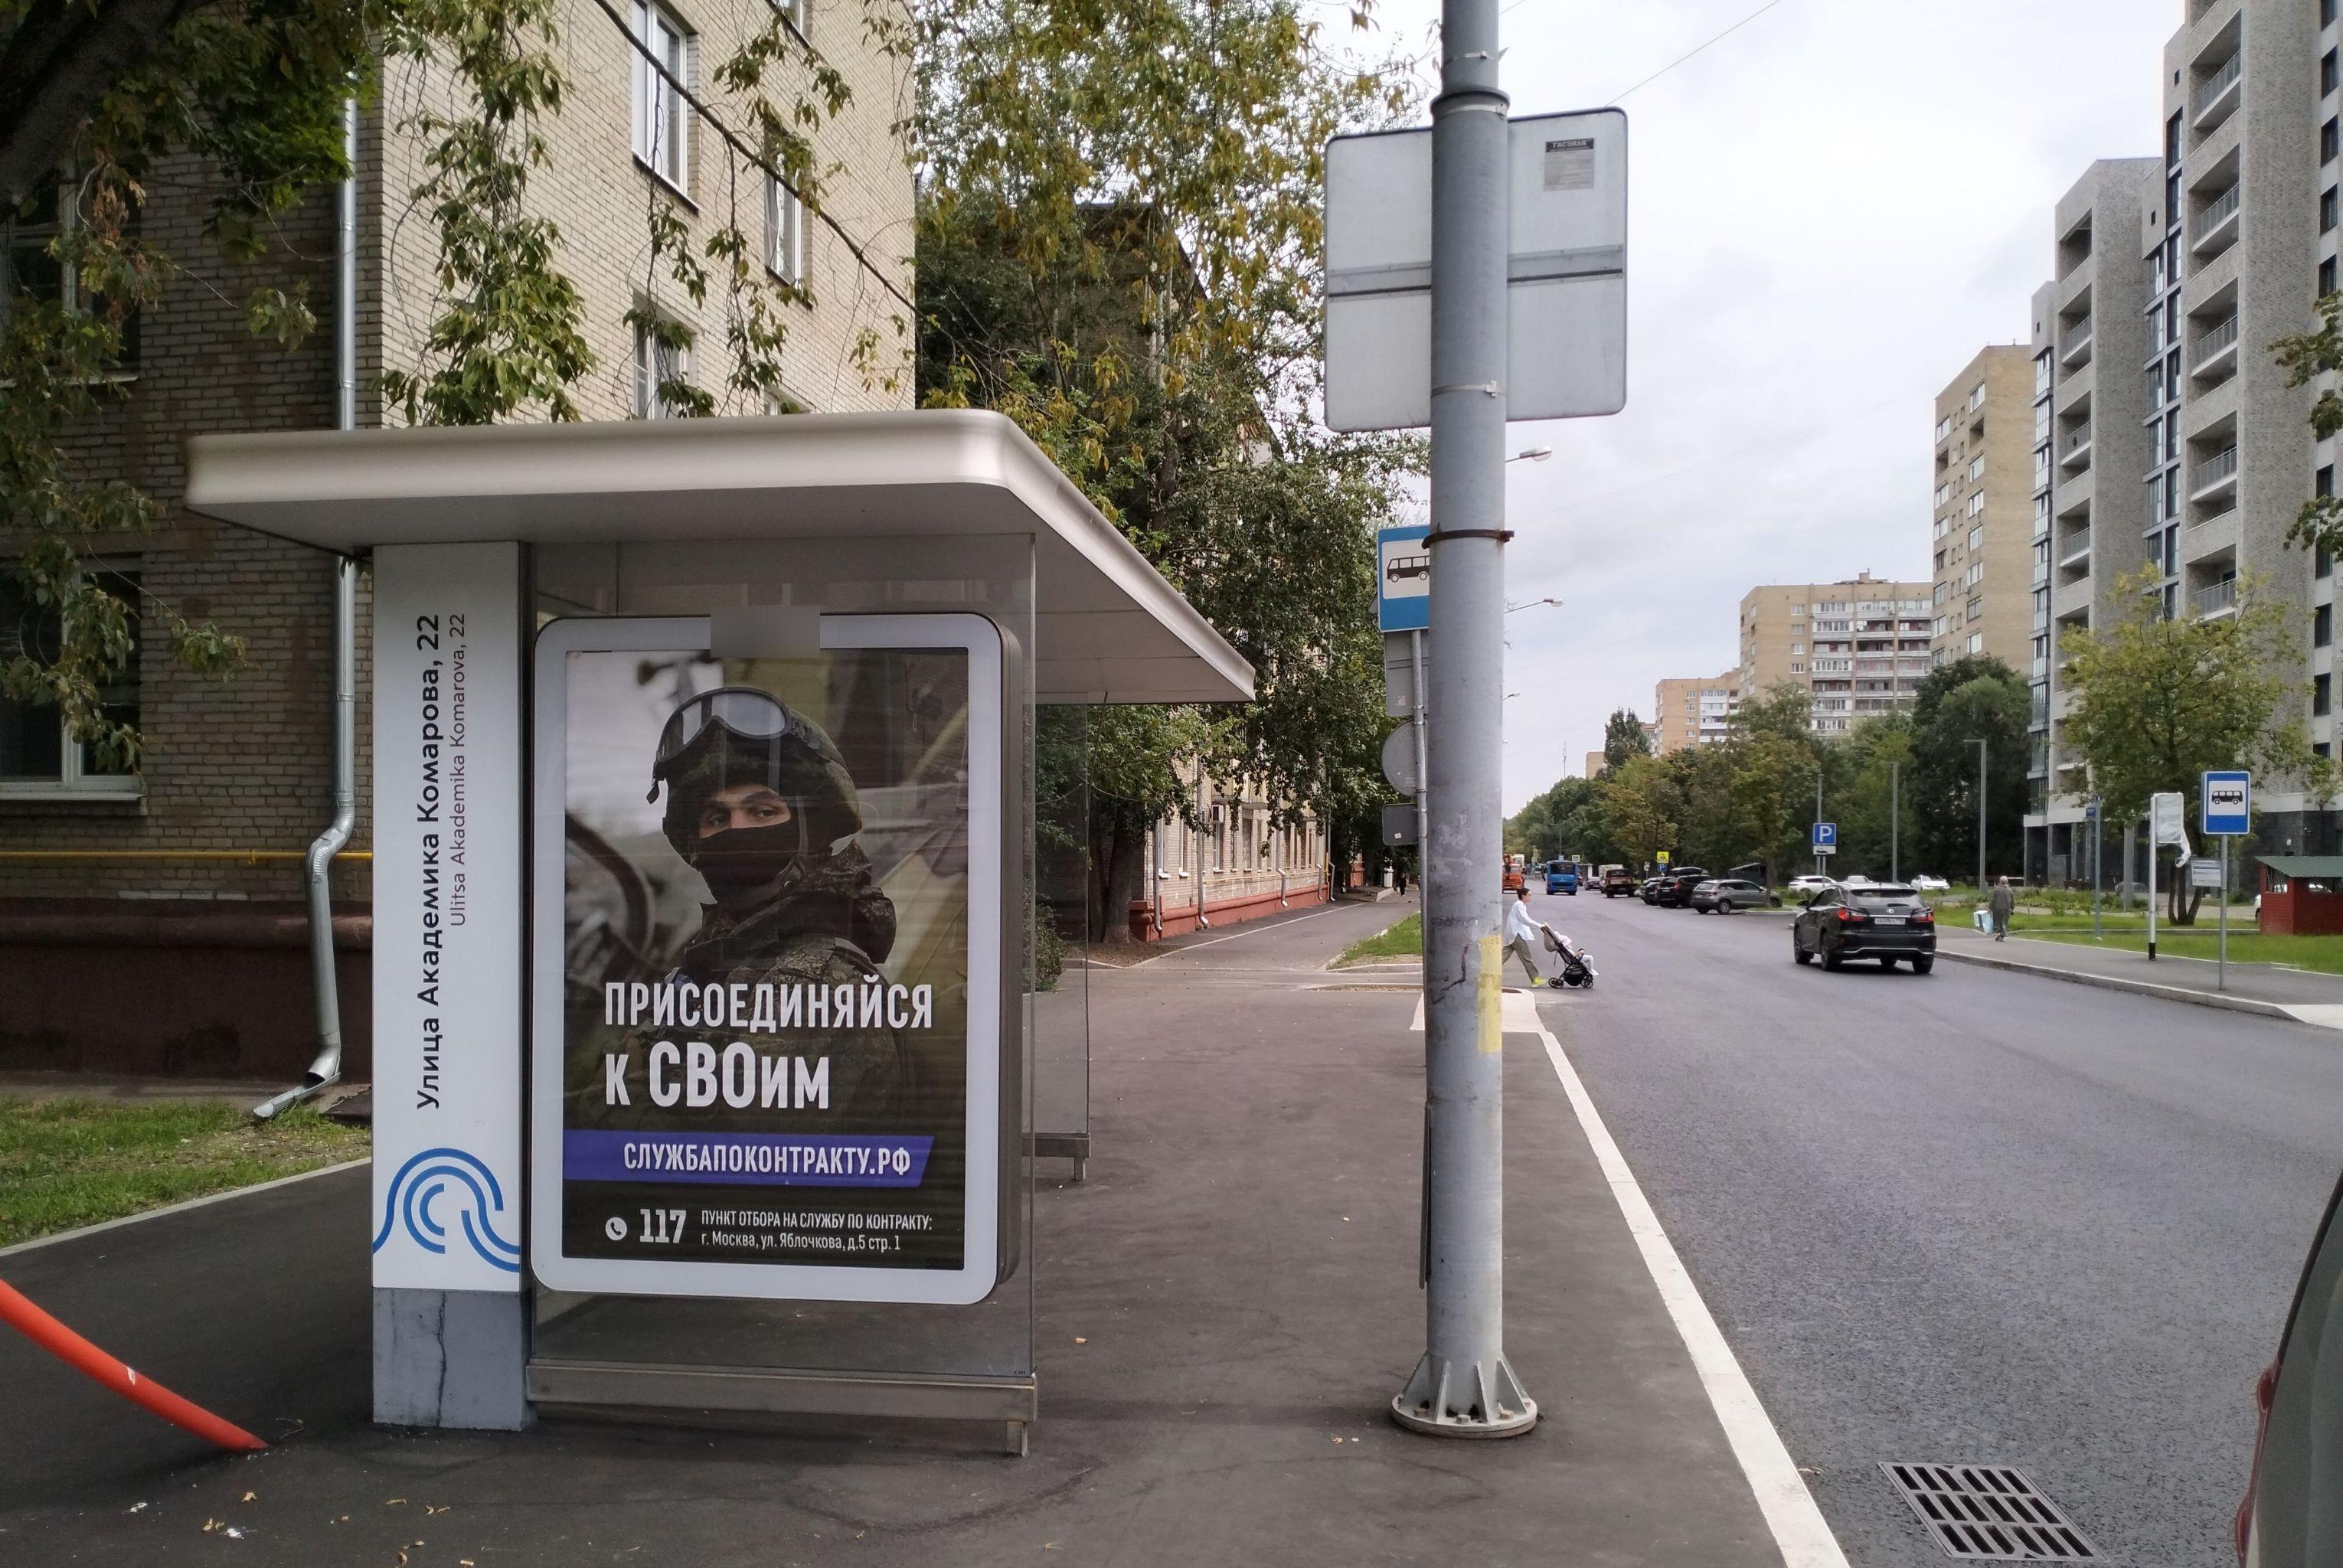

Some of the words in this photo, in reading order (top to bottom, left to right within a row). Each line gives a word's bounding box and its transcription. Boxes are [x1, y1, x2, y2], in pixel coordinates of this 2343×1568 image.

[417, 614, 439, 651] 22
[449, 613, 465, 638] 22
[449, 645, 467, 747] Komarova,
[417, 660, 444, 822] Комарова,
[449, 755, 466, 866] Akademika
[1819, 825, 1832, 842] P
[417, 834, 443, 1007] Академика
[449, 873, 466, 926] Ulitsa
[605, 975, 933, 1034] ПРИСОЕДИНЯЙСЯ
[417, 1017, 443, 1109] Улица
[623, 1143, 911, 1176] СЛУЖБАПОКОНТРАКТУ.РФ
[639, 1209, 687, 1244] 117
[701, 1210, 737, 1226] ПУНКТ
[739, 1211, 780, 1227] ОТБОРА
[783, 1212, 798, 1227] НА
[800, 1213, 844, 1228] СЛУЖБУ
[848, 1214, 863, 1229] ПО
[866, 1214, 933, 1230] КОНТРАКТУ:
[701, 1233, 709, 1246] г.
[712, 1231, 759, 1249] Москва,
[760, 1235, 777, 1250] ул.
[779, 1233, 845, 1251] Яблочкова,
[868, 1237, 892, 1253] стр.
[894, 1235, 901, 1250] 1
